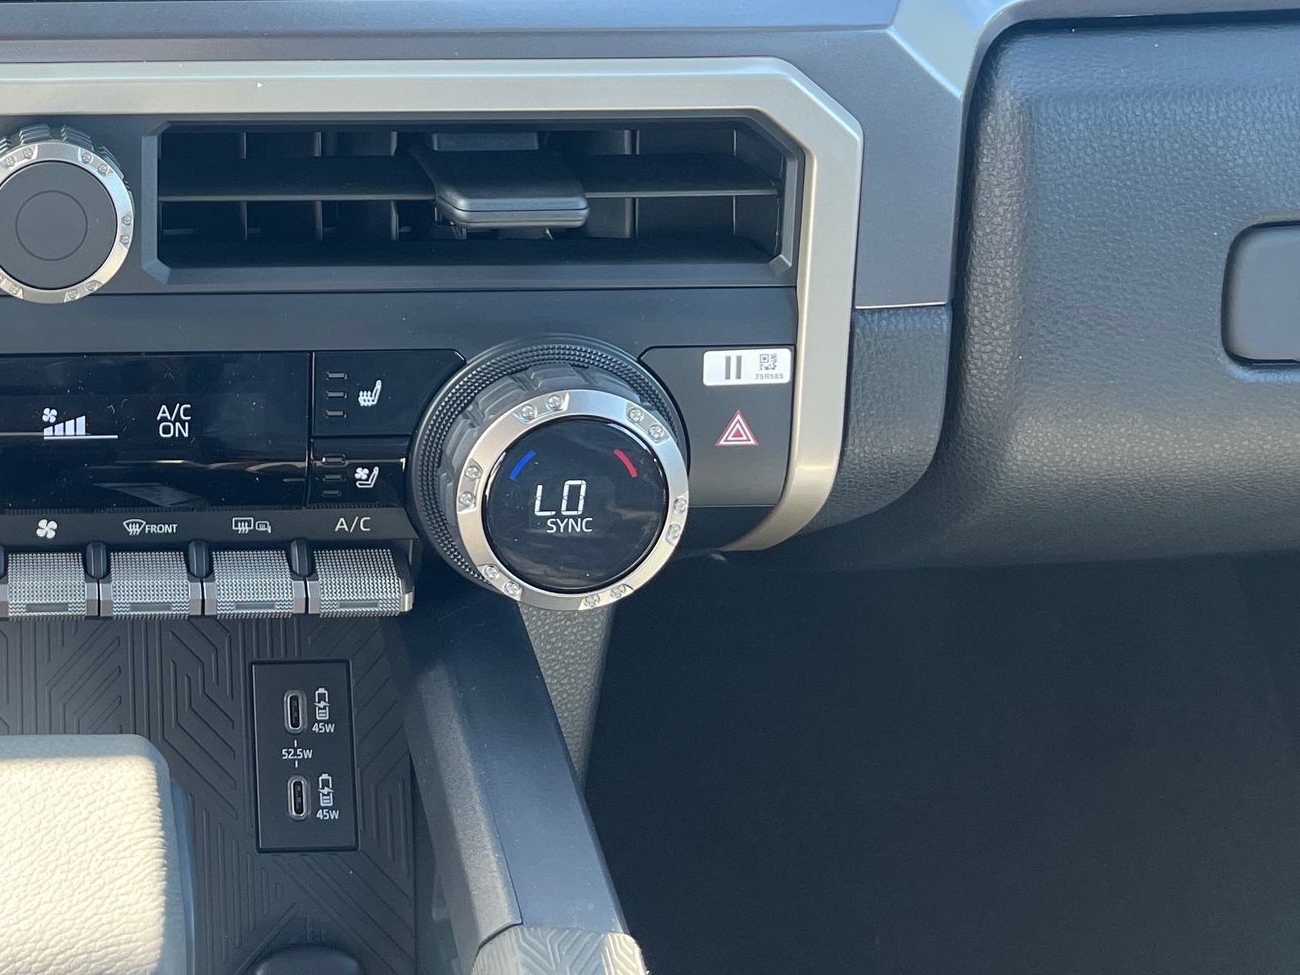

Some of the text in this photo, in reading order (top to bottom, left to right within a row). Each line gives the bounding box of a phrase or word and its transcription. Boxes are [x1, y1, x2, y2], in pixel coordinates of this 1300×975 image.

[156, 403, 192, 421] A/C
[158, 421, 190, 439] ON
[144, 523, 178, 535] FRONT
[334, 516, 372, 533] A/C
[546, 517, 592, 533] SYNC
[312, 722, 335, 733] 45W
[282, 748, 313, 759] 52.5W
[316, 809, 340, 820] 45W
